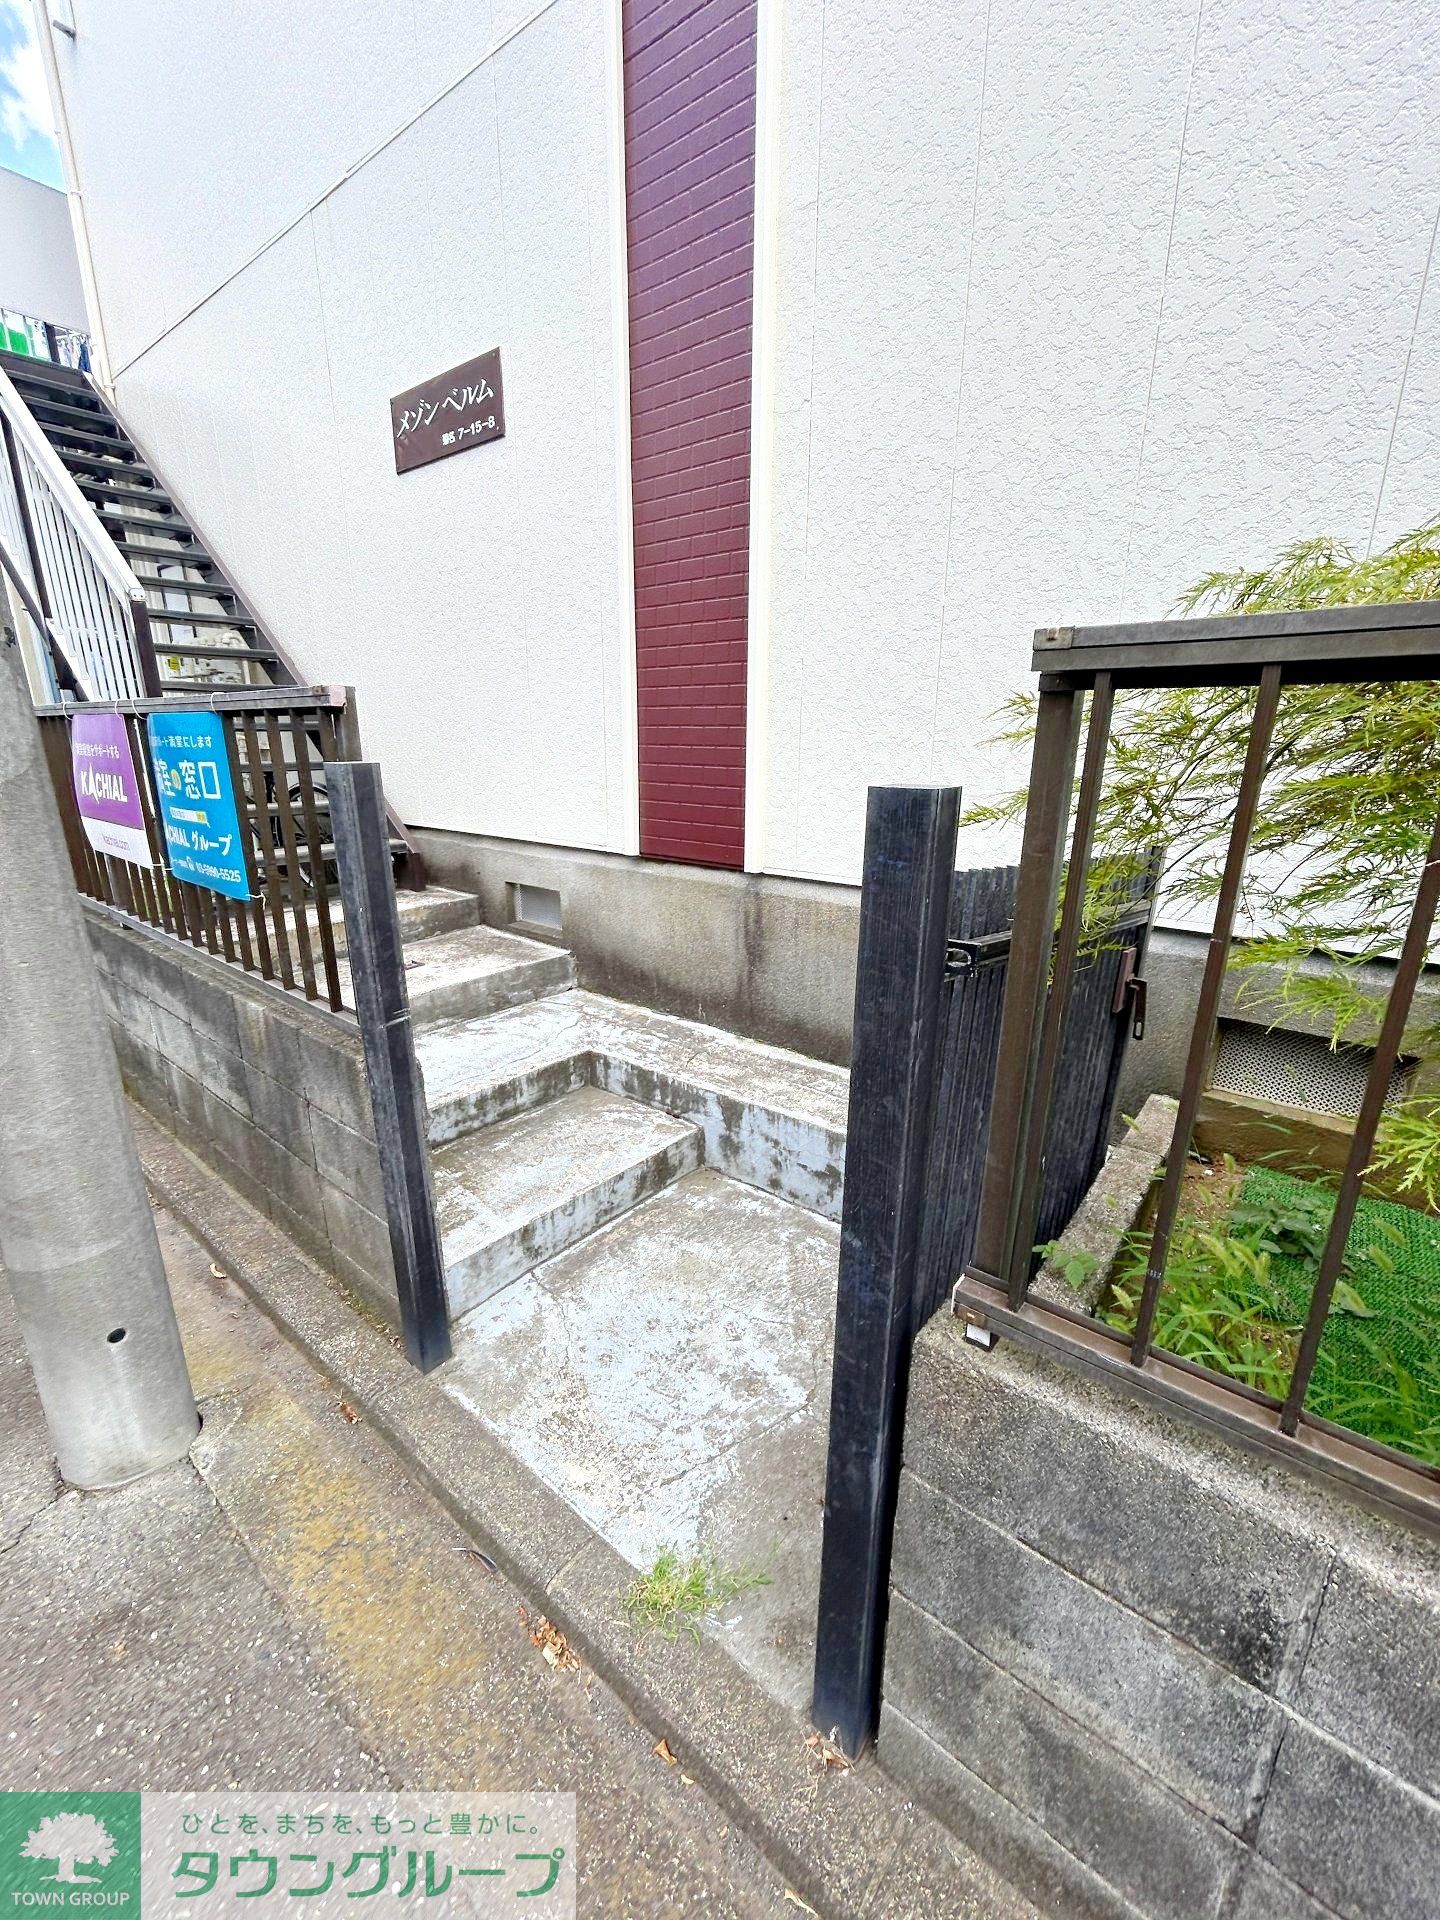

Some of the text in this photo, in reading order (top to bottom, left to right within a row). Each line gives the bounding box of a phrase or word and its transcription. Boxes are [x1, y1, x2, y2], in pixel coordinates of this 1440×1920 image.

[458, 415, 496, 440] 7-15-8
[80, 763, 128, 804] KACHIAL
[192, 834, 233, 856] グループ
